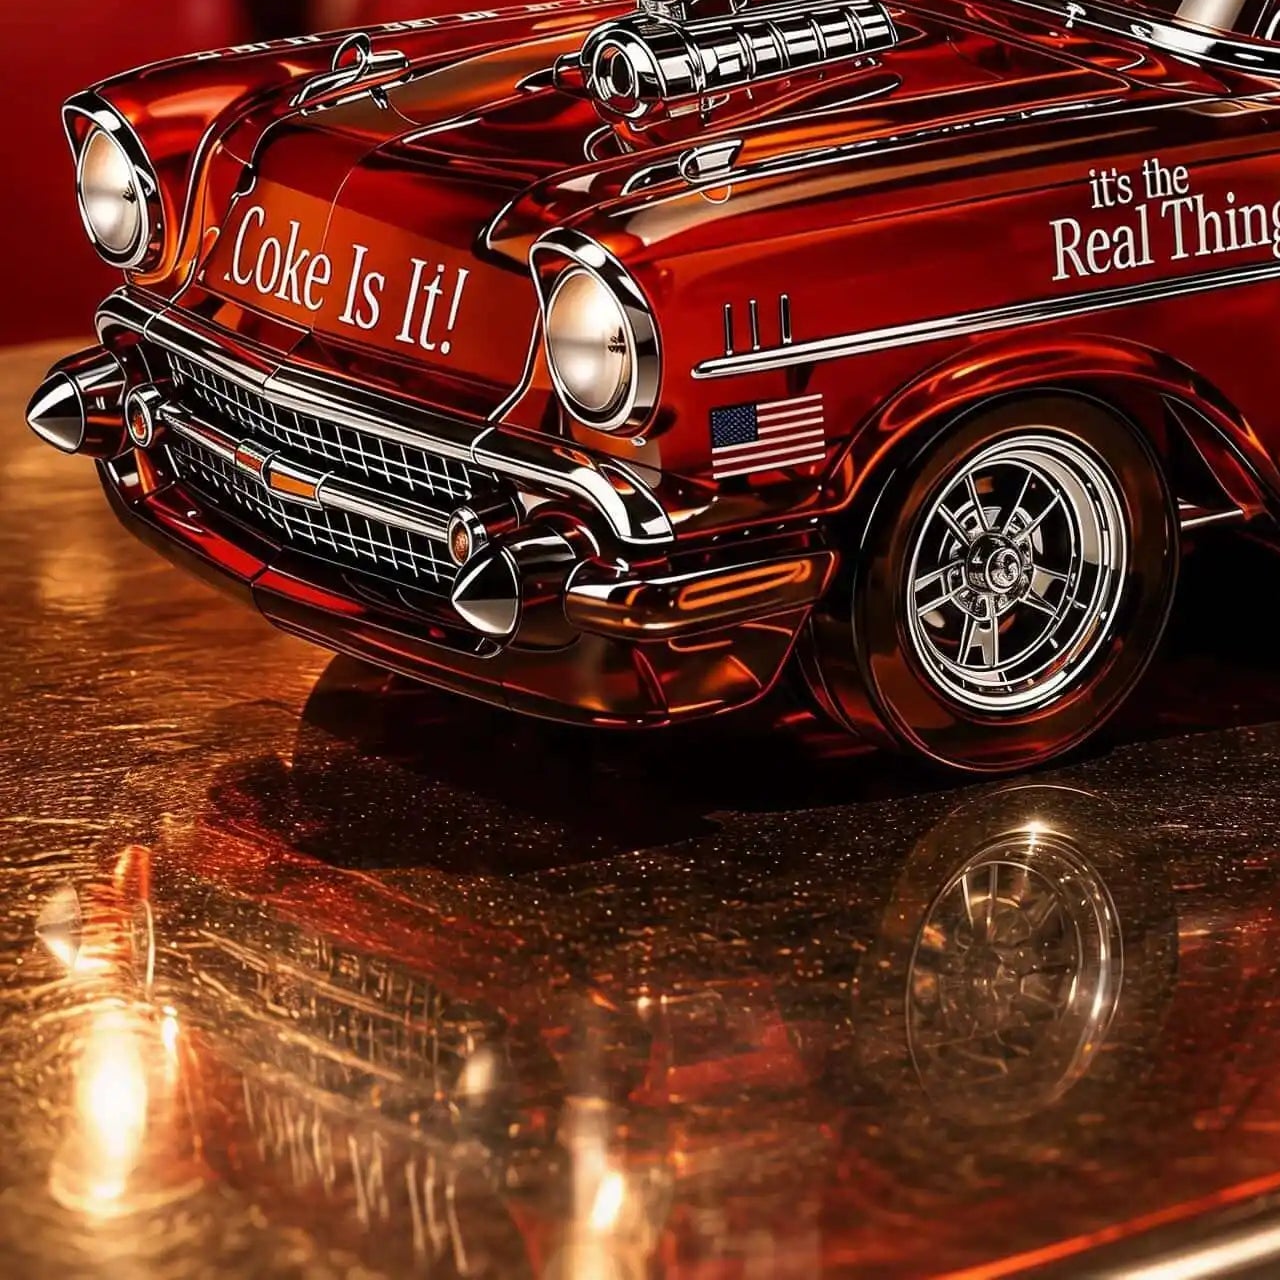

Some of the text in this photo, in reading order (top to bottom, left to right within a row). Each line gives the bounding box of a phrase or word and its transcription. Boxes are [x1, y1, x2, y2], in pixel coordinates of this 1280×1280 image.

[1088, 157, 1190, 209] it's the
[1049, 204, 1155, 281] Real
[338, 243, 386, 330] Is
[394, 257, 471, 356] It!
